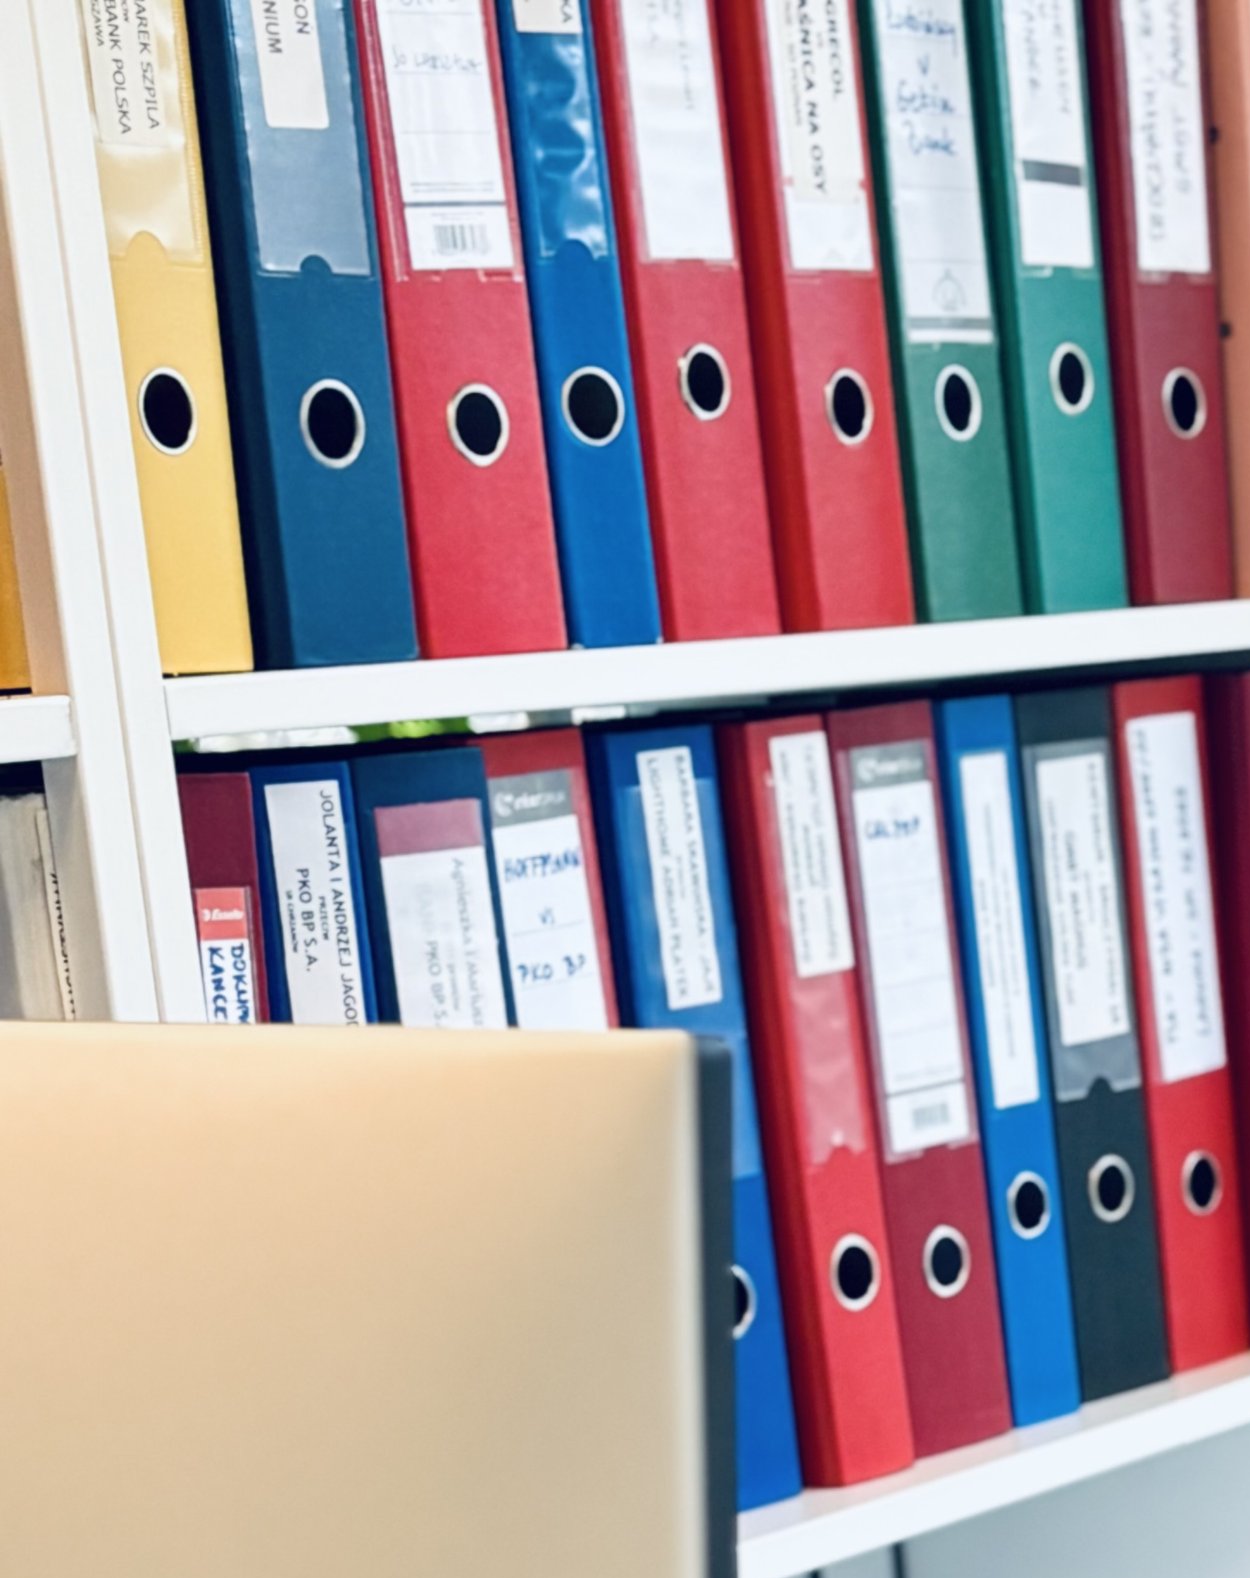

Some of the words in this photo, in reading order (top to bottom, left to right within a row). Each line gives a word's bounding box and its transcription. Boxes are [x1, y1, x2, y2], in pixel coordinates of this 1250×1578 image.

[112, 58, 132, 134] POLSKA
[141, 61, 160, 129] SZPILA
[806, 101, 819, 135] NA
[811, 144, 828, 195] OSY
[296, 868, 313, 904] PKO
[320, 790, 340, 872] JOLANTA
[331, 889, 351, 967] ANDRZEJ
[451, 858, 475, 946] Agnieszka
[301, 911, 315, 932] BP
[303, 938, 318, 973] S.A.
[424, 941, 442, 976] PKO
[208, 946, 229, 1023] KANCE
